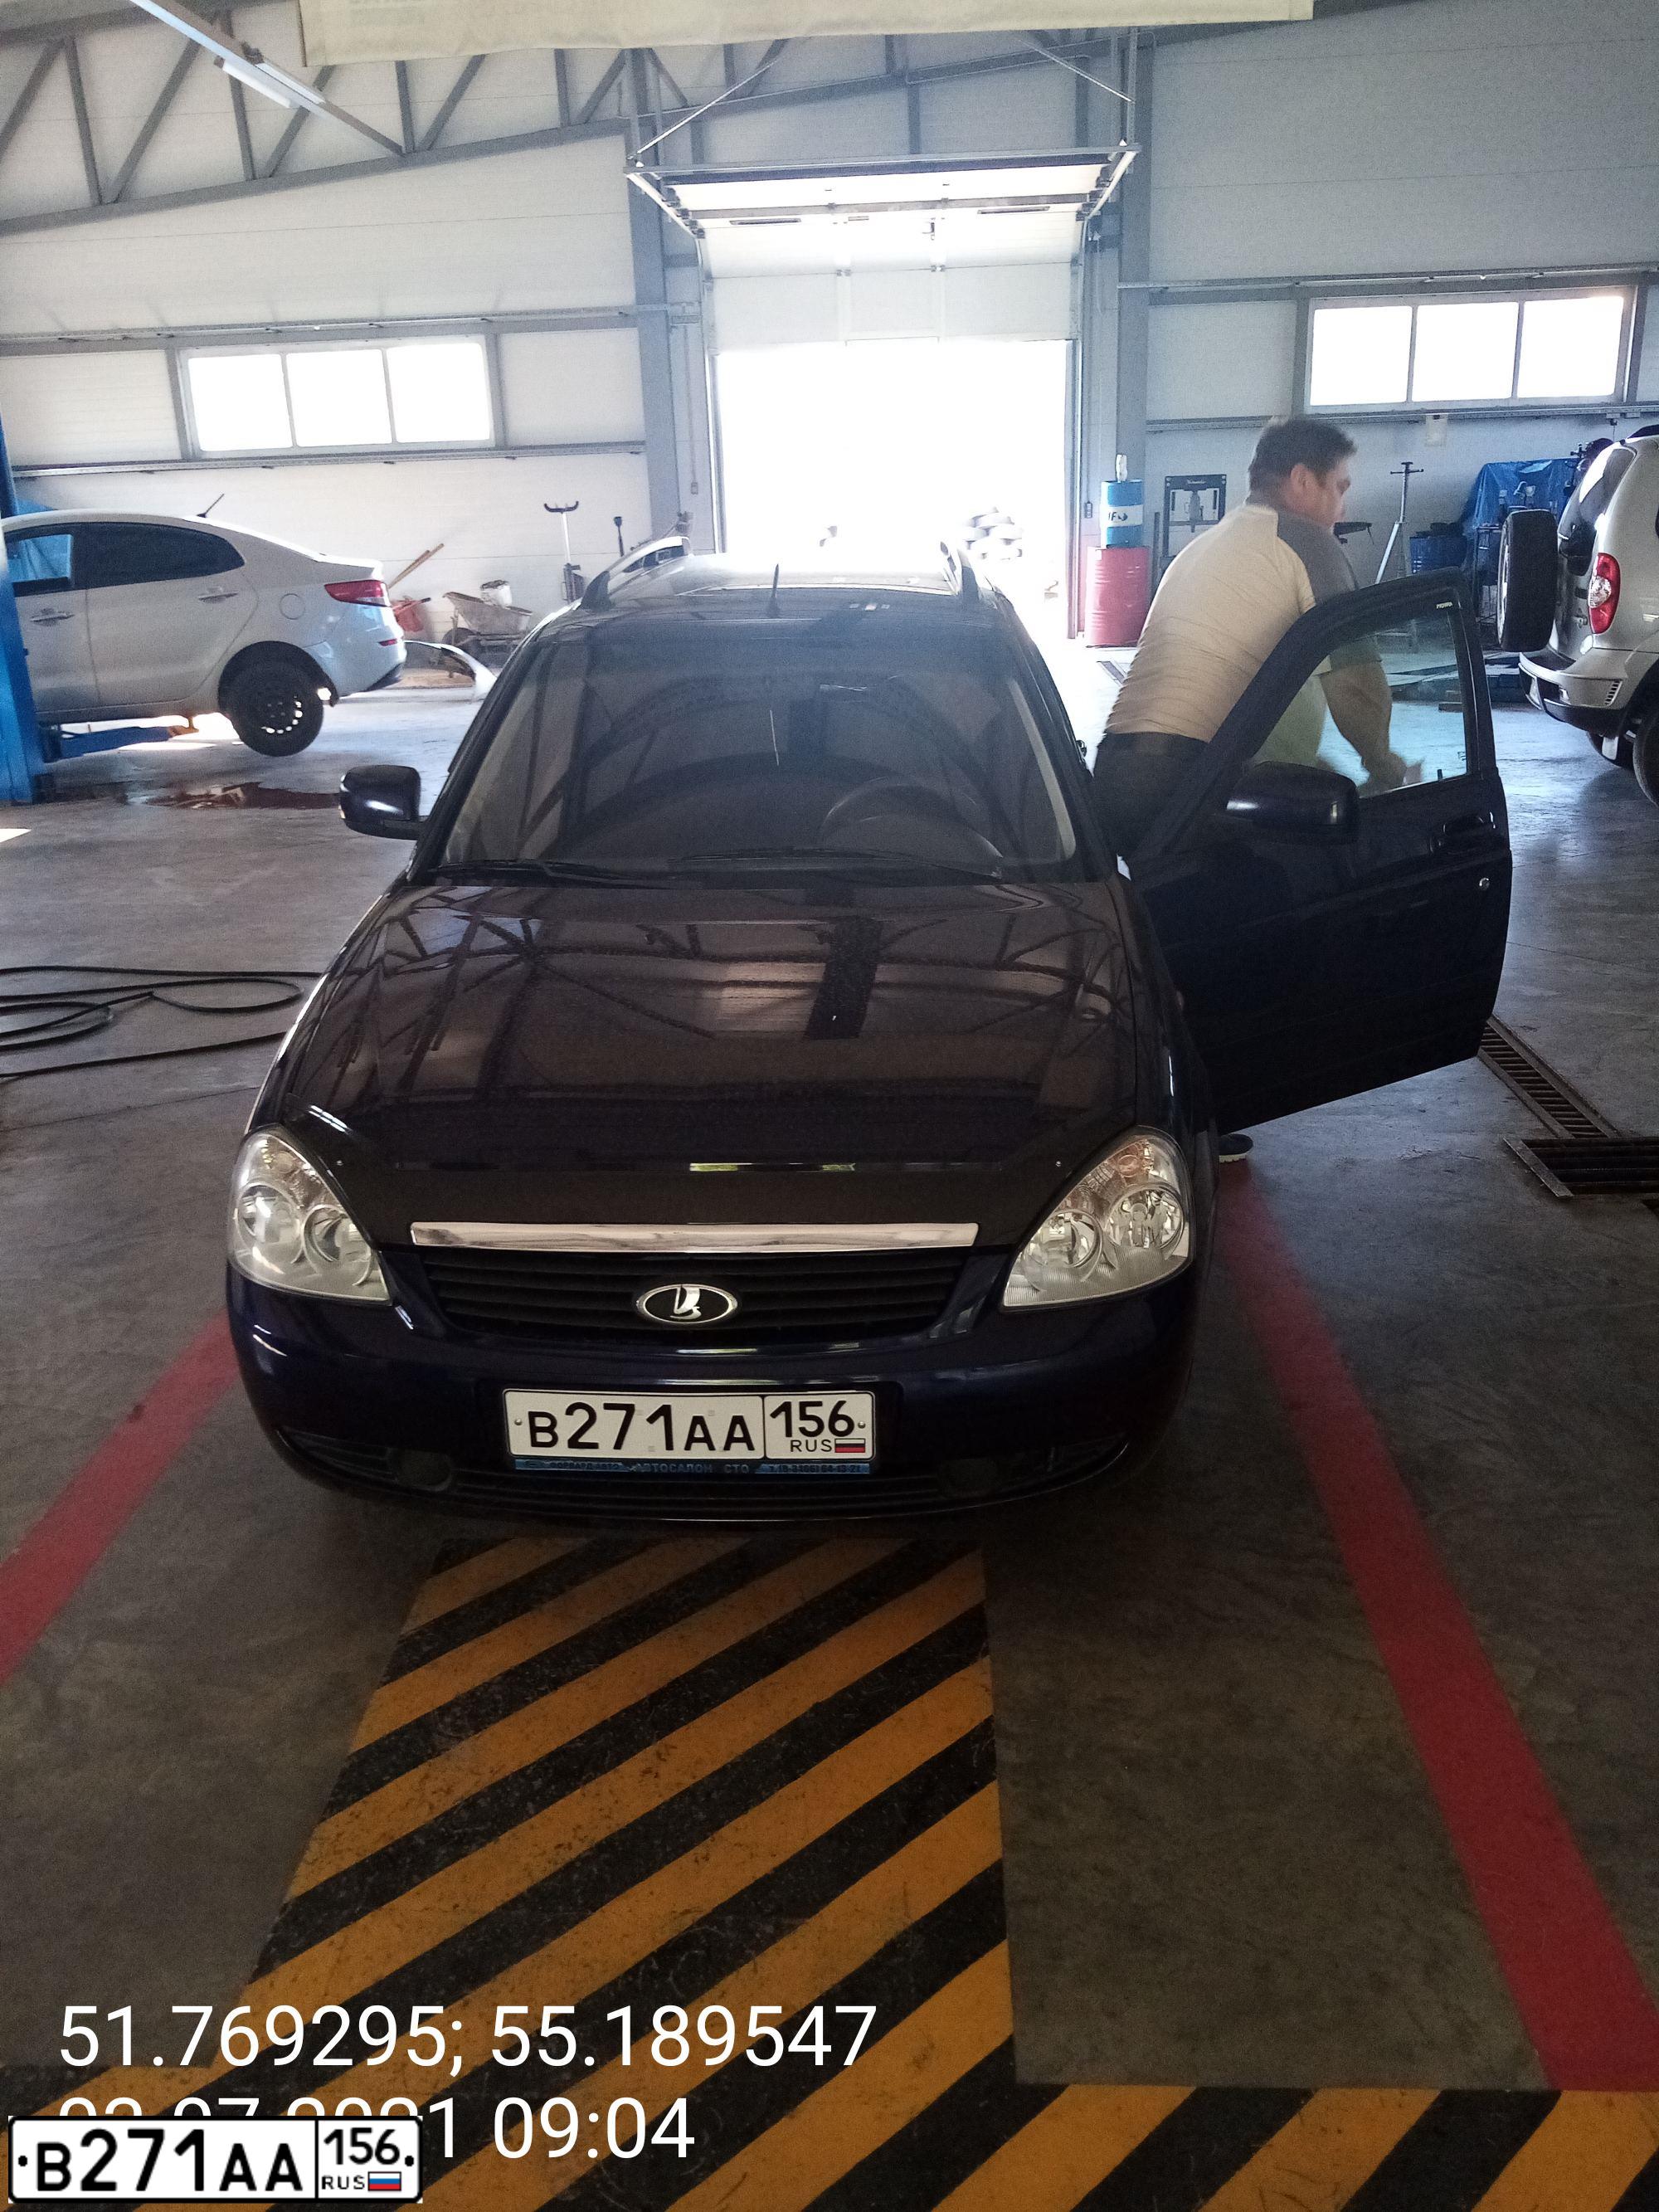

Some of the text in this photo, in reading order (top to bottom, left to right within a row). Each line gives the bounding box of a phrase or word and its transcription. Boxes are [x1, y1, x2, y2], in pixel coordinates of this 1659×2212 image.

[769, 1400, 855, 1438] 156
[790, 1439, 833, 1453] RUS
[724, 1464, 750, 1474] СТО
